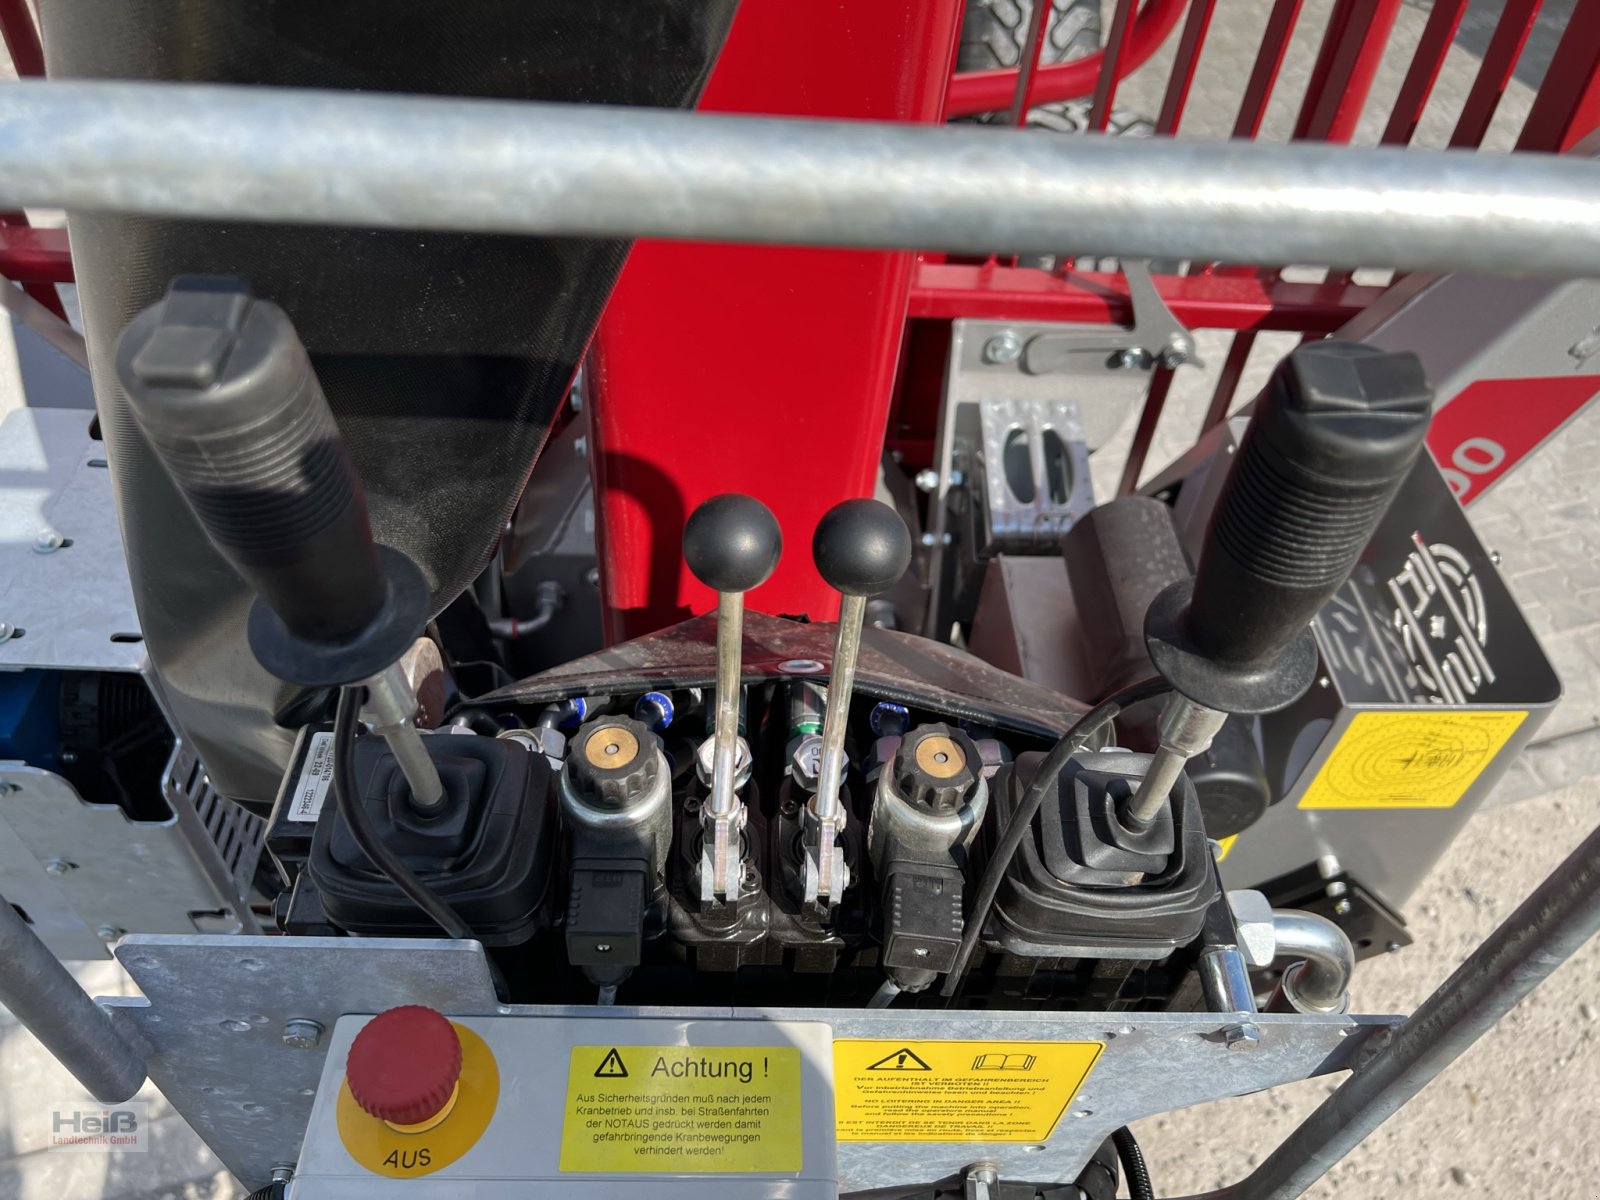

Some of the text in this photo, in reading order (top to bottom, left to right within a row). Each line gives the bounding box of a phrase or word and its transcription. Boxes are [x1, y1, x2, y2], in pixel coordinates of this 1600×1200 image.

[651, 1056, 769, 1083] Achtung !
[576, 1093, 771, 1105] Aus Sicherheitsgründen muß nach jedem
[576, 1106, 631, 1116] Kranbetrieb
[634, 1106, 653, 1116] und
[681, 1106, 696, 1116] bei
[698, 1106, 769, 1116] Straßenfahrten
[586, 1119, 761, 1131] der NOTAUS gedrückt werden damit
[593, 1132, 761, 1144] gefahrbringende Kranbewegungen
[634, 1145, 684, 1156] verhindert
[383, 1148, 432, 1169] AUS
